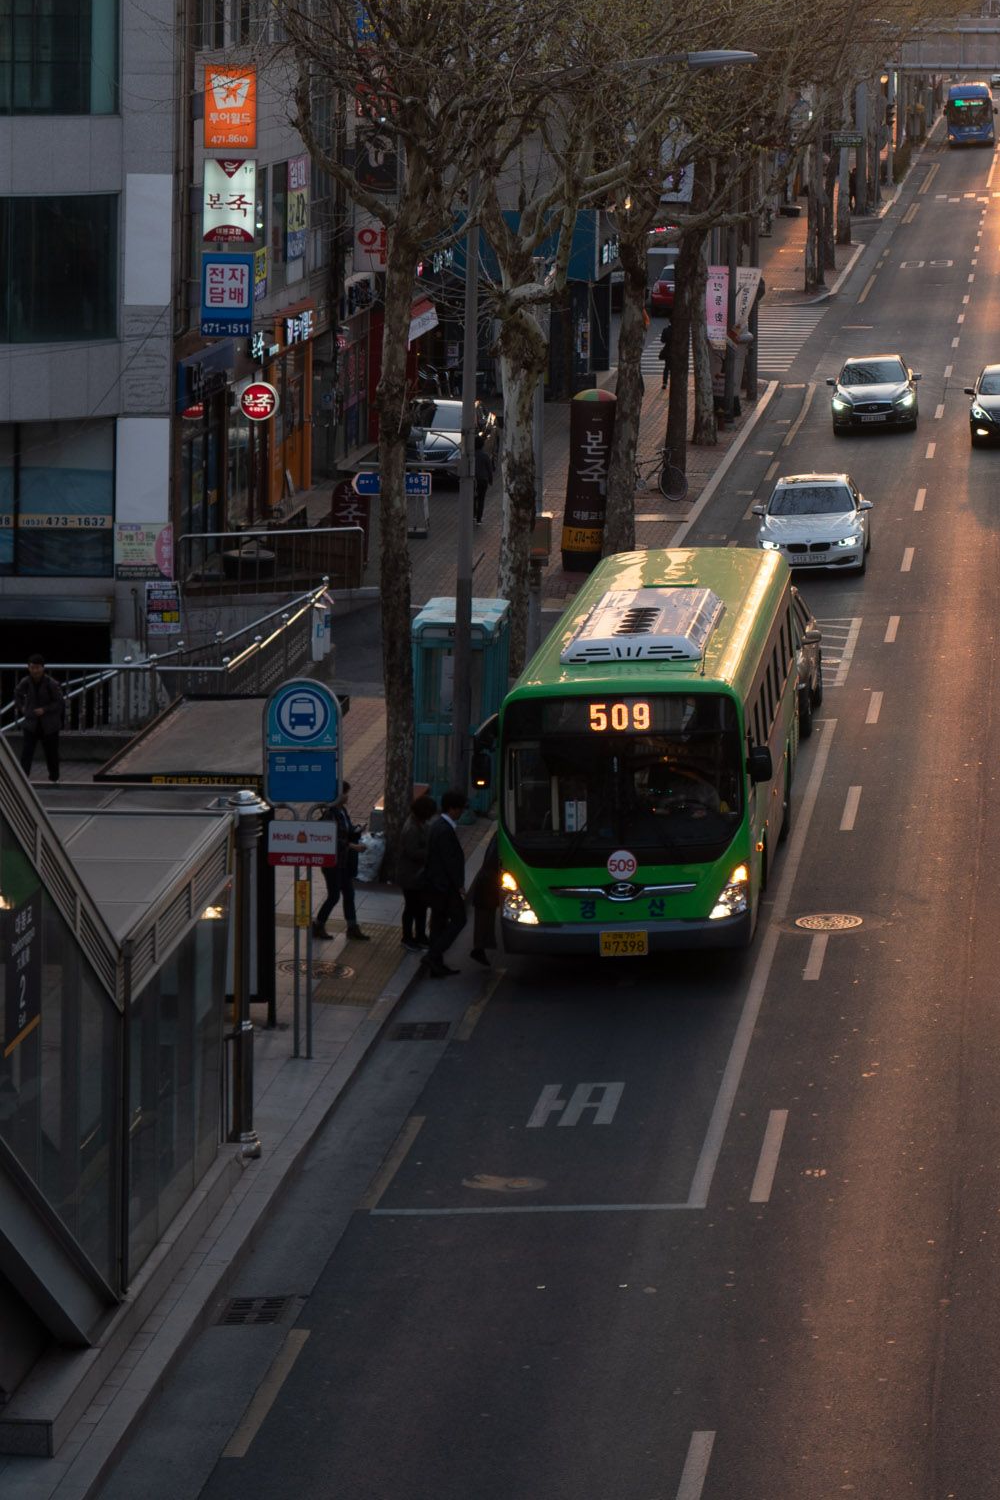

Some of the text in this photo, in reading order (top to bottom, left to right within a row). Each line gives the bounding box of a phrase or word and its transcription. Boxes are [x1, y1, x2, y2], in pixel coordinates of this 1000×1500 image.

[209, 112, 251, 124] 투어월드
[206, 193, 253, 217] 본죽
[209, 267, 245, 284] 전자
[209, 288, 244, 303] 담배
[202, 323, 249, 333] 471-1511
[244, 393, 274, 412] 본죽
[577, 430, 608, 495] 본죽
[46, 517, 105, 526] 473-1632
[573, 510, 605, 520] 대봉교
[589, 702, 650, 731] 509
[271, 734, 281, 743] 버
[609, 859, 634, 872] 509
[580, 900, 665, 919] 경 산
[19, 974, 27, 1009] 2
